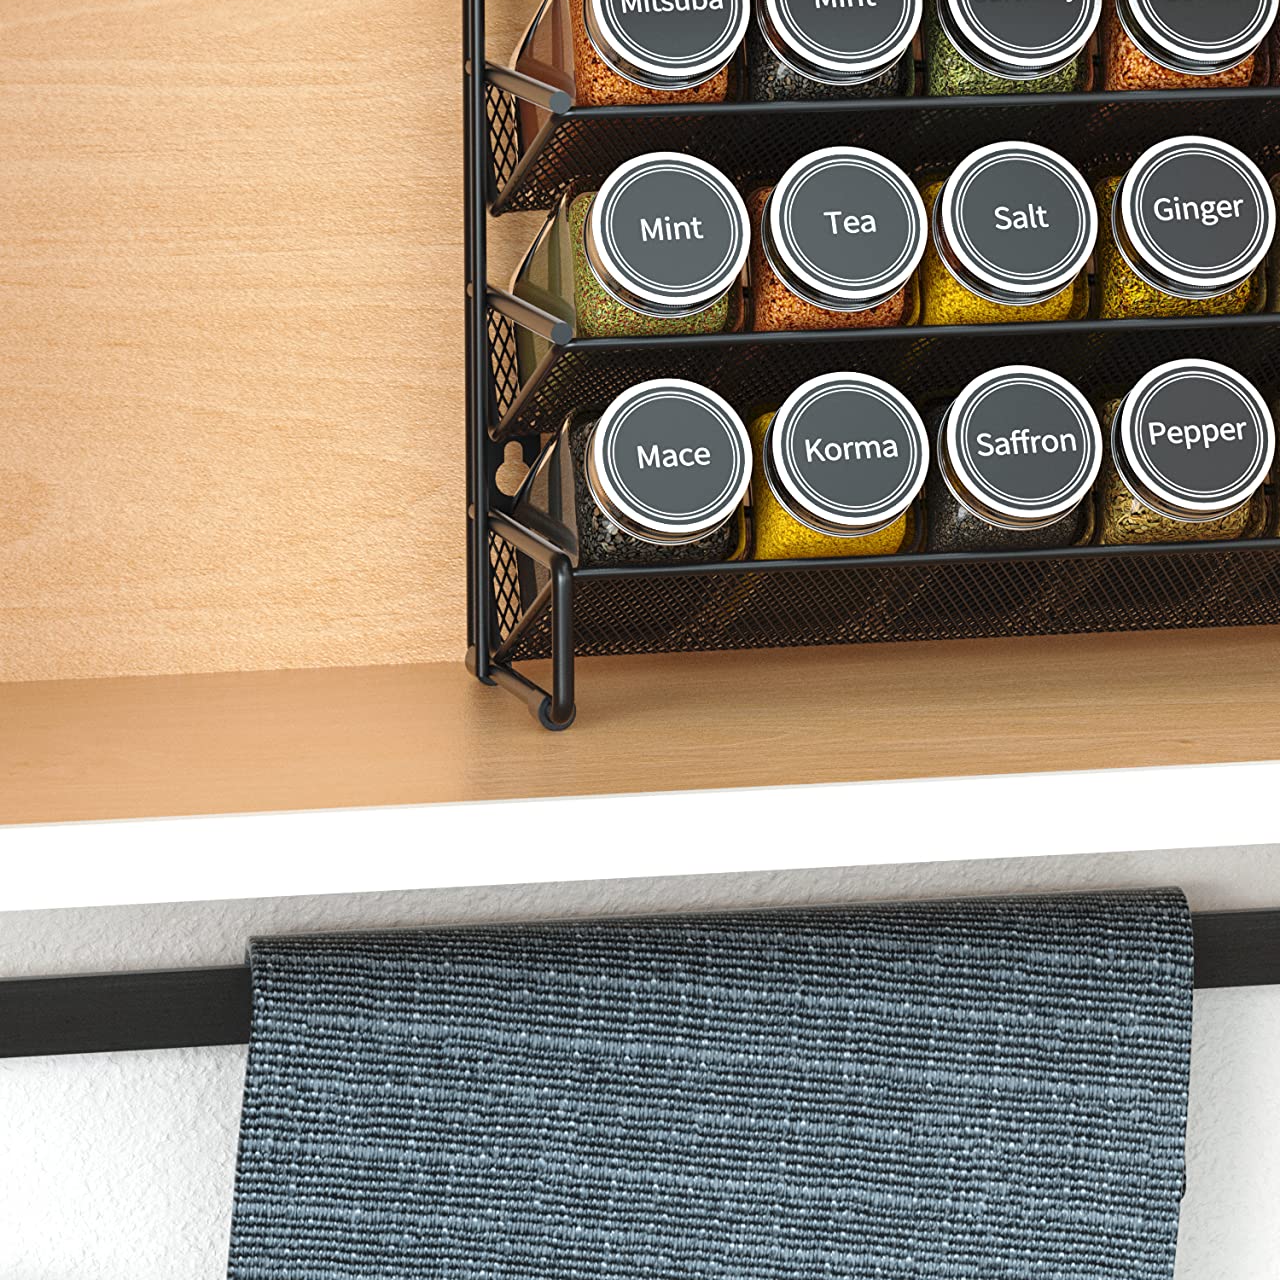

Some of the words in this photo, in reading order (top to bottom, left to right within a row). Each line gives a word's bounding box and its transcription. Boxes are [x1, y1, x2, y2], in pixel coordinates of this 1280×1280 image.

[822, 210, 877, 235] Tea
[994, 203, 1050, 231] Salt
[1153, 196, 1244, 226] Ginger
[639, 215, 705, 242] Mint
[976, 428, 1077, 457] Saffron
[1148, 421, 1247, 450] Pepper
[636, 444, 711, 470] Mace
[804, 438, 899, 463] Korma
